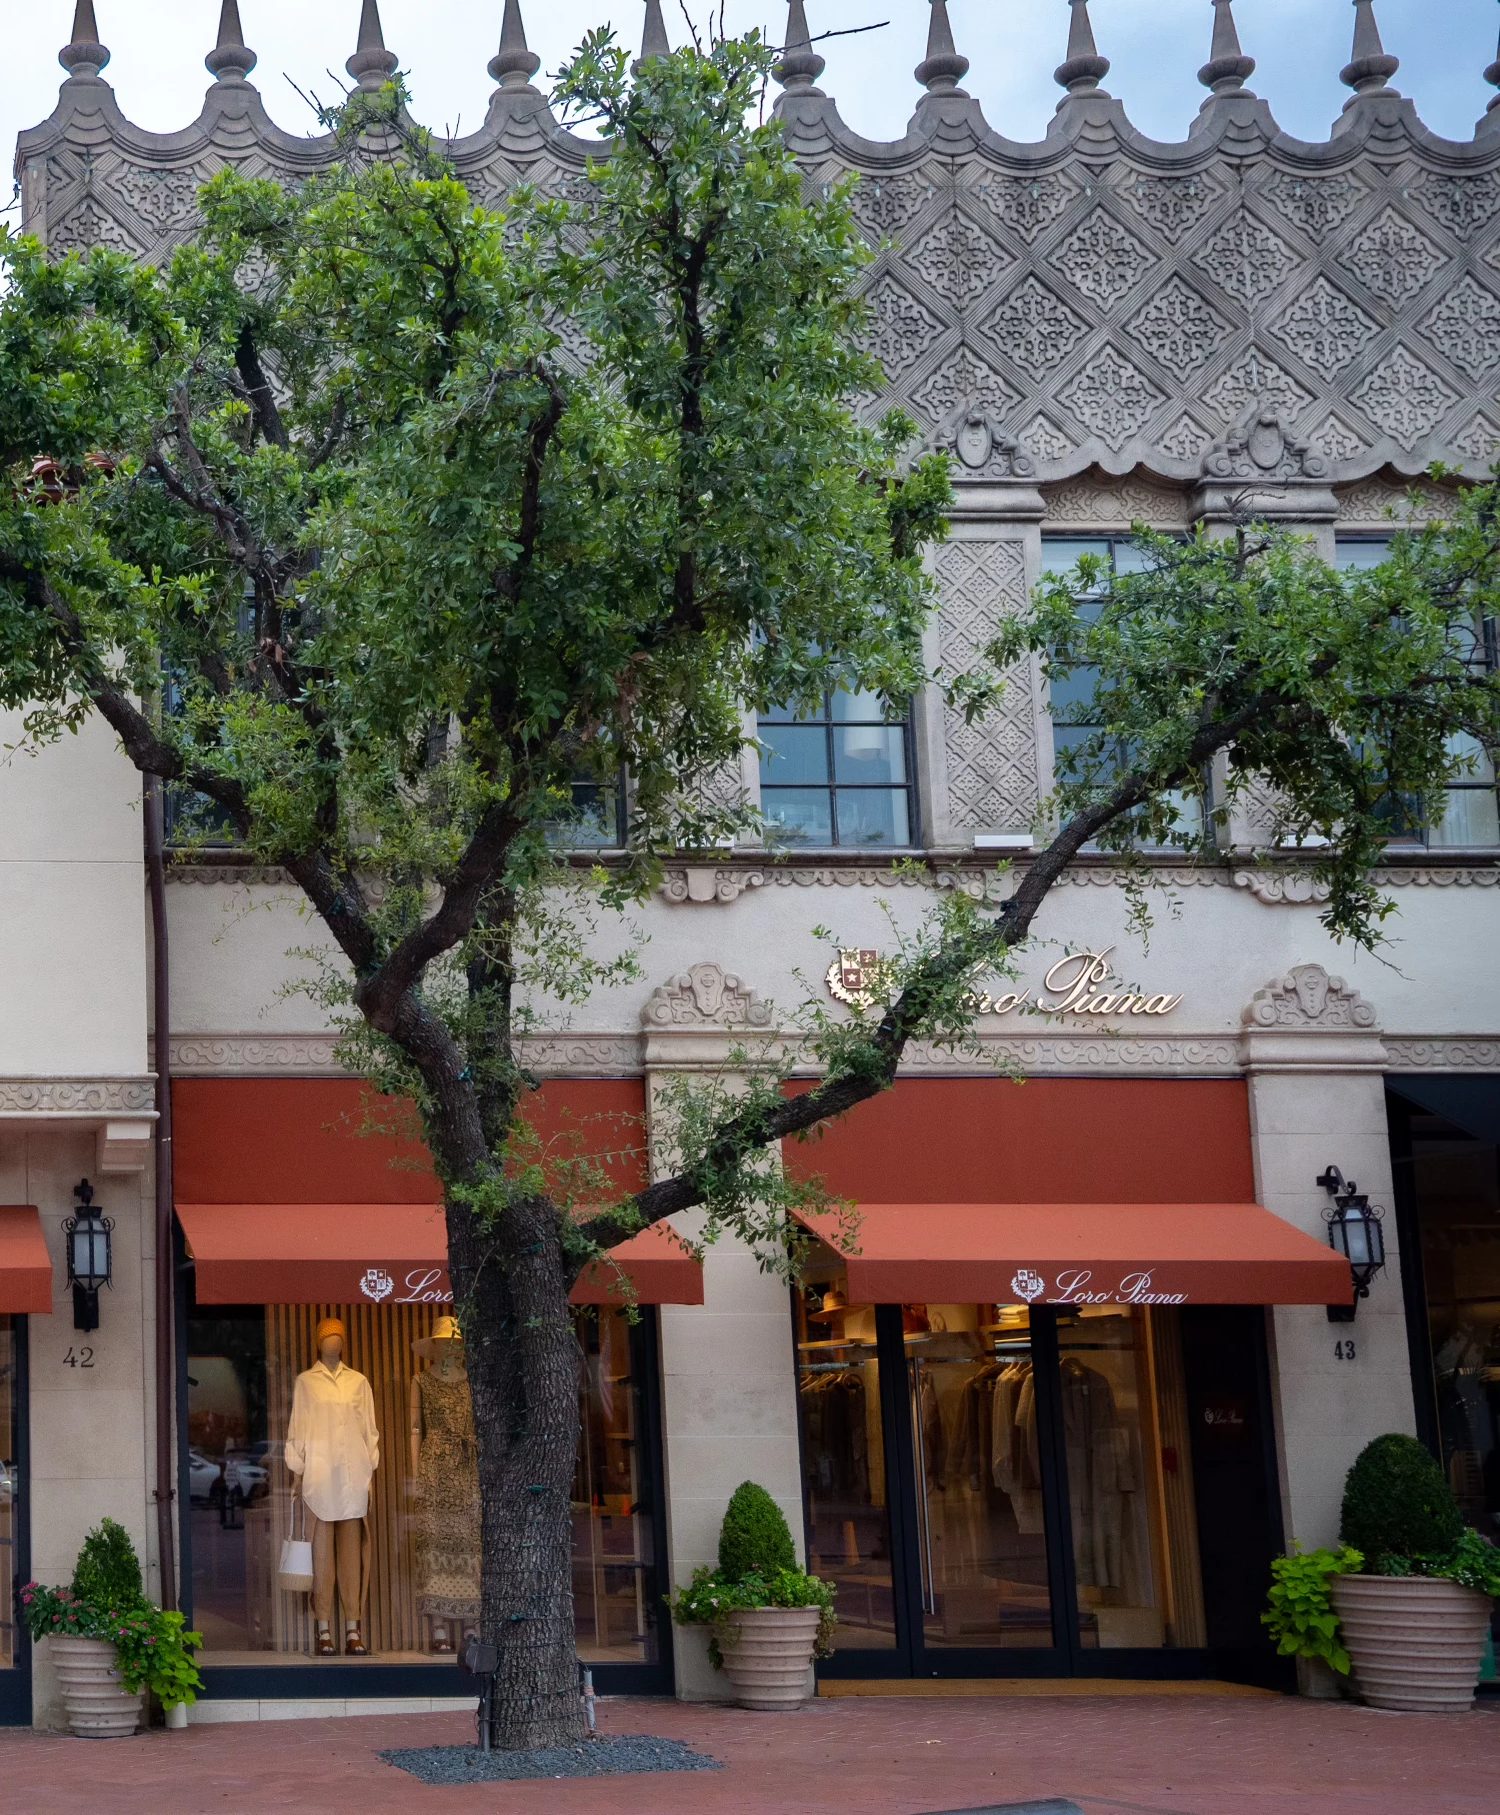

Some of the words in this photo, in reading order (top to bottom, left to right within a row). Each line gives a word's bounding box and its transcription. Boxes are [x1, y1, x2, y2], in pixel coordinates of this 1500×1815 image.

[1036, 943, 1185, 1015] Piana
[1046, 1269, 1113, 1304] Loro
[1115, 1267, 1189, 1304] Piana
[62, 1346, 95, 1368] 42
[1334, 1340, 1356, 1360] 43
